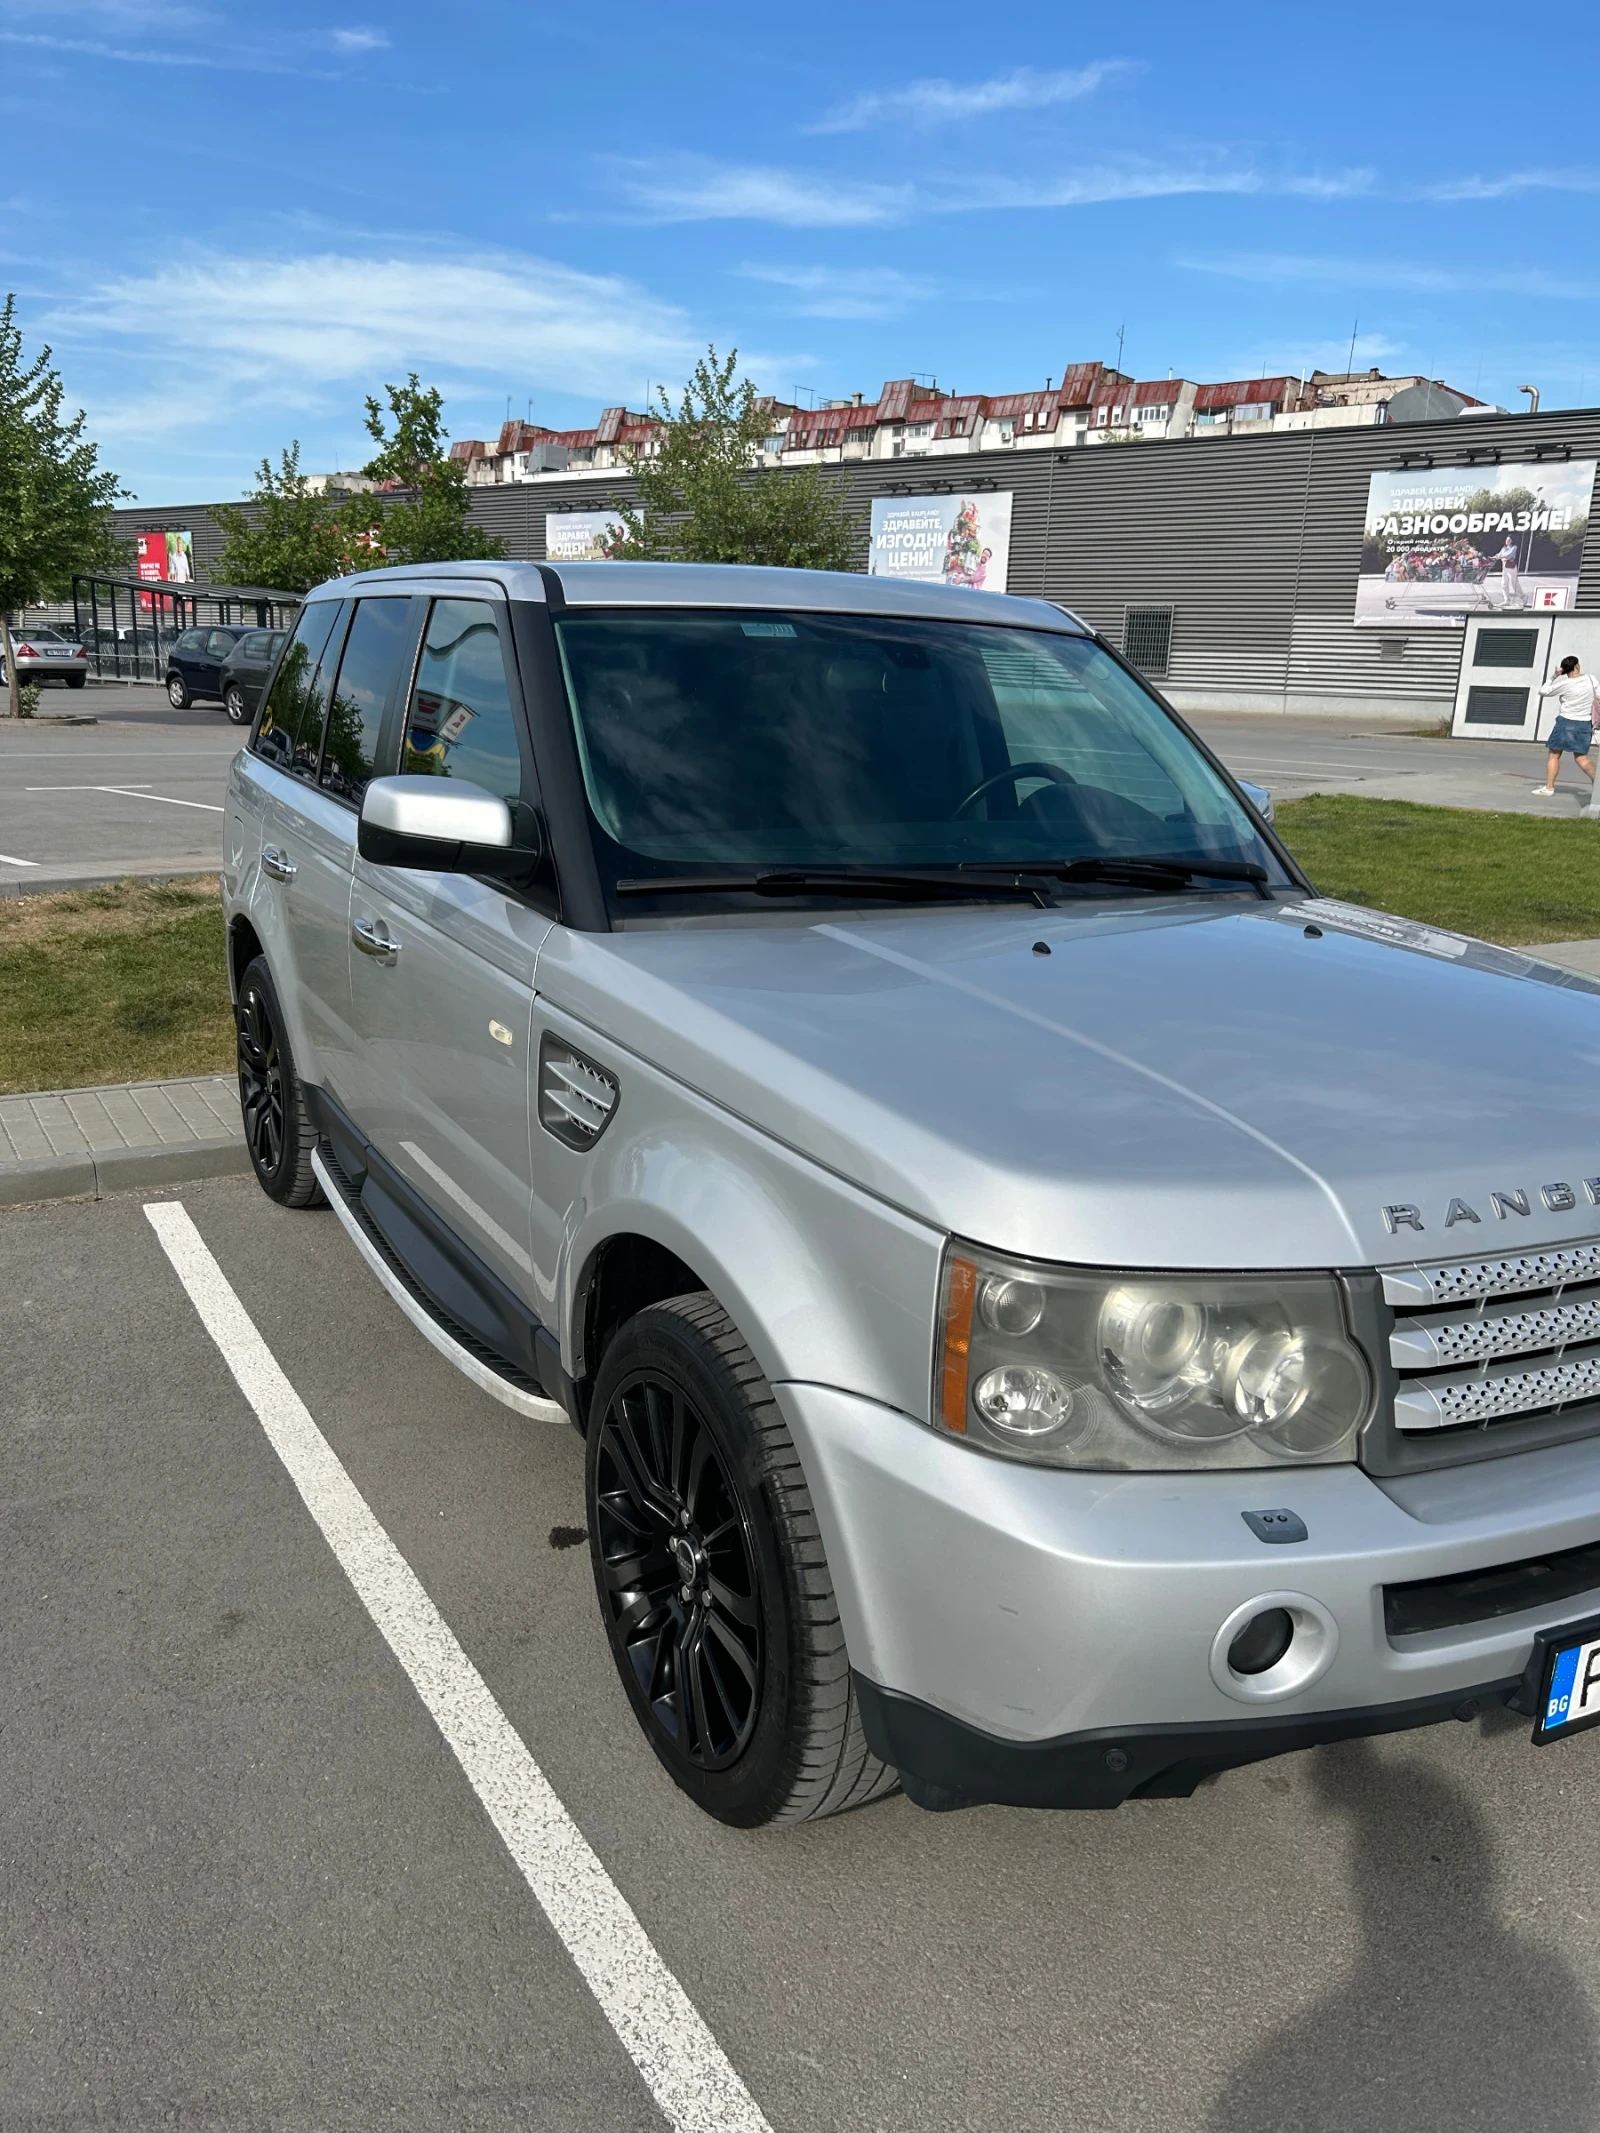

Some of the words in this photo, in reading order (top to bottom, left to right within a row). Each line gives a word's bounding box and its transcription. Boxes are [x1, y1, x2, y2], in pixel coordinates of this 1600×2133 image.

[1390, 486, 1427, 497] ЗДРАВЕЙ,
[1428, 485, 1474, 495] KAUFLAND!
[1391, 493, 1469, 514] ЗДРАВЕЙ,
[882, 516, 943, 533] ЗДРАВЕЙТЕ,
[1370, 506, 1573, 537] РАЗНООБРАЗИЕ!
[549, 541, 586, 559] РОДЕН
[876, 531, 948, 551] ИЗГОДНИ
[1396, 545, 1410, 553] 000
[888, 547, 934, 571] ЦЕНИ!
[1547, 1694, 1569, 1717] BG
